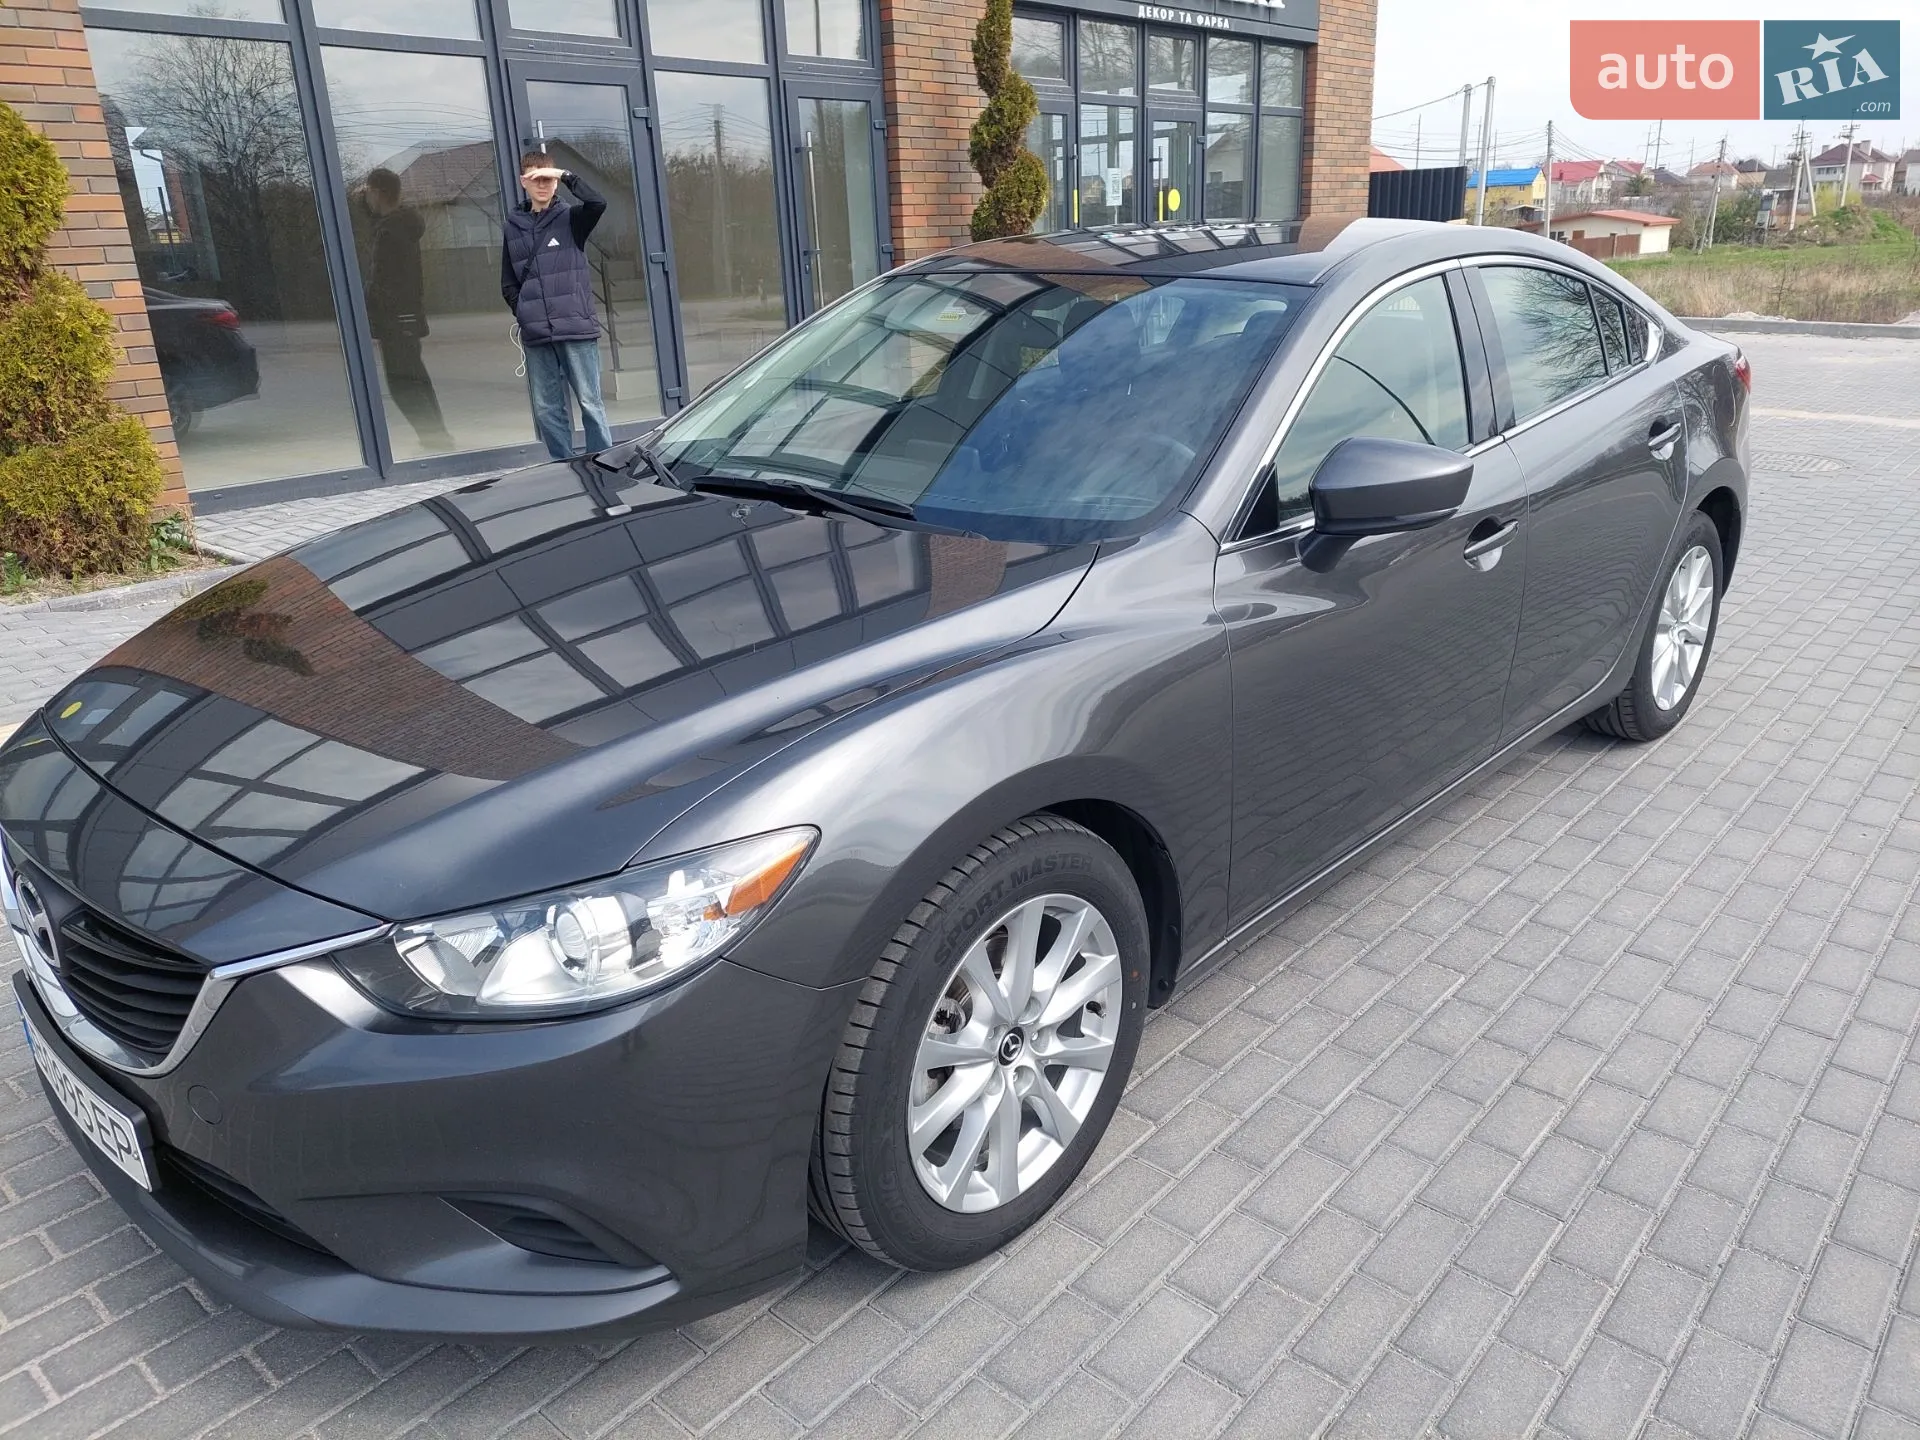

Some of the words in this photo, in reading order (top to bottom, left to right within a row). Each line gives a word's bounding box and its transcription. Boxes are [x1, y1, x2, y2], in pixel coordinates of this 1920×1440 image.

[1138, 5, 1175, 20] ДЕКОР
[1179, 11, 1192, 24] ТА
[1196, 14, 1230, 29] ФАРБА
[933, 879, 1006, 966] SPORT
[1010, 853, 1094, 888] MASTER
